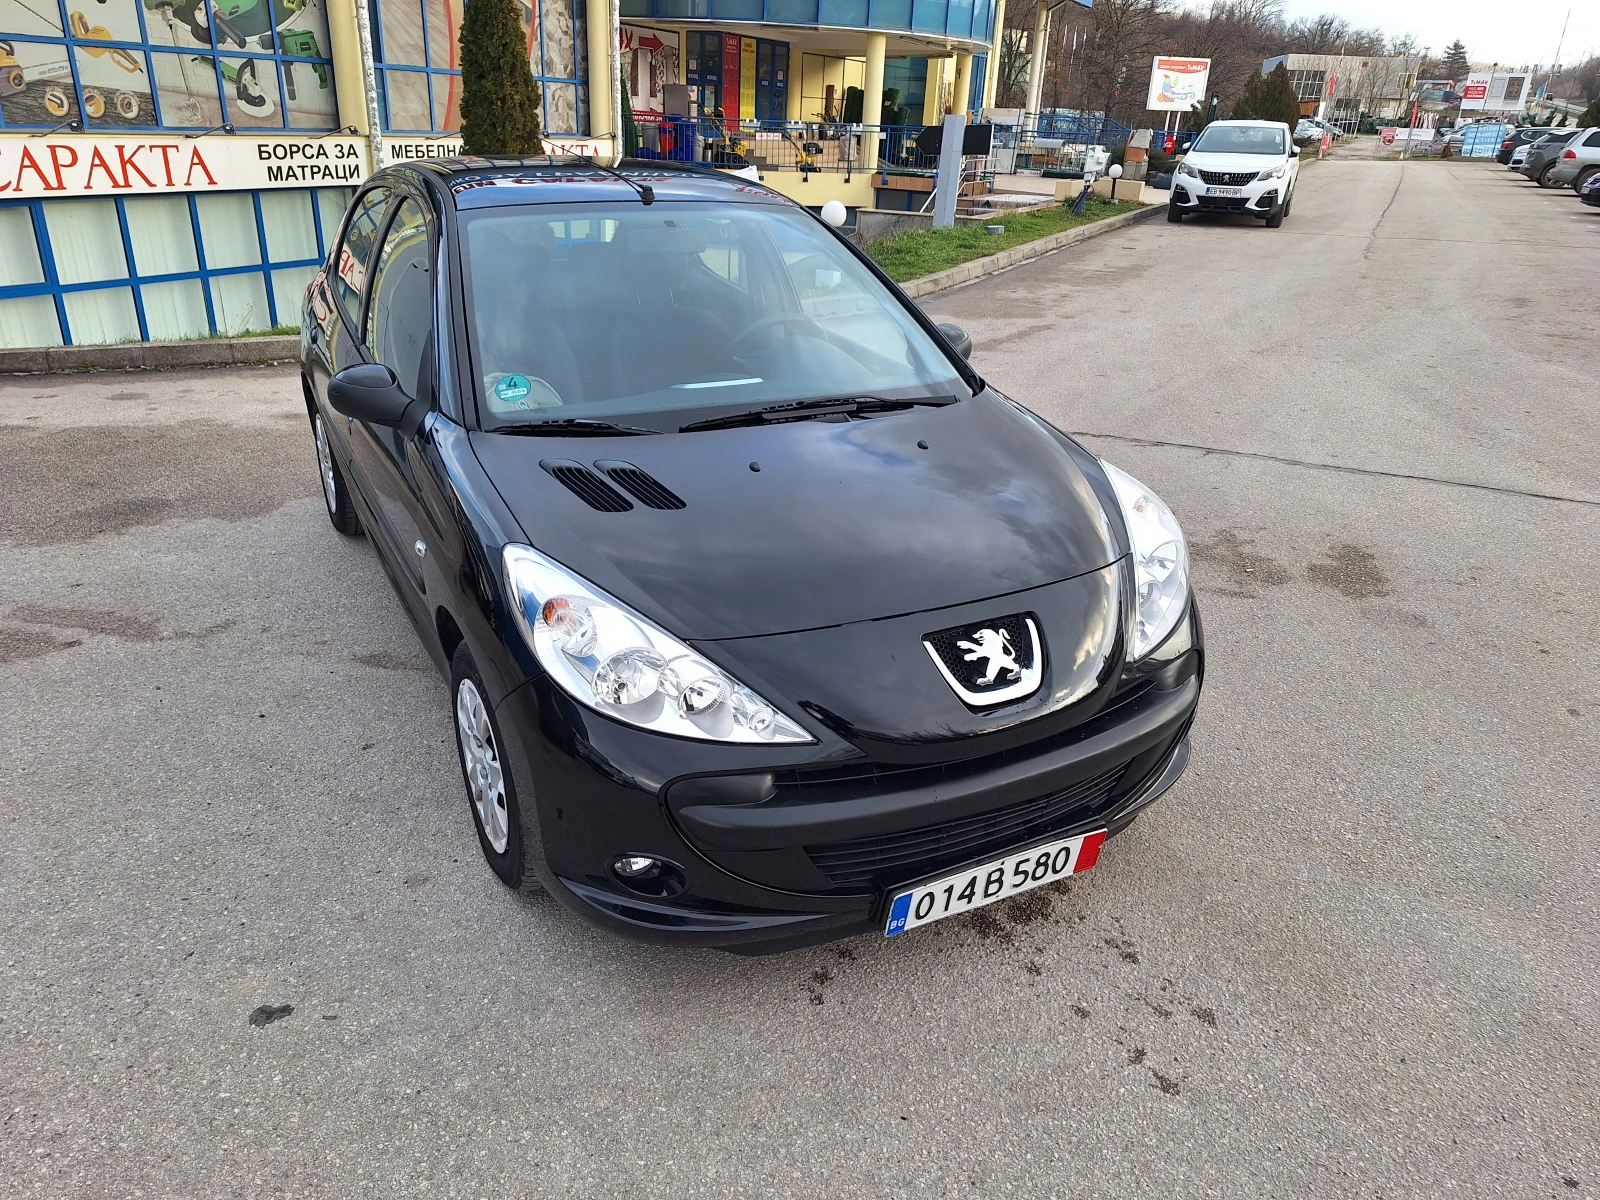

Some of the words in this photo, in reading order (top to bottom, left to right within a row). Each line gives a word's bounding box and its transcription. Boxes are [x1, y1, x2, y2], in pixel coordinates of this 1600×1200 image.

[257, 143, 329, 160] БОРСА
[334, 143, 359, 159] ЗА
[267, 163, 361, 182] МАТРАЦИ
[507, 376, 519, 388] 4
[889, 917, 906, 930] BG
